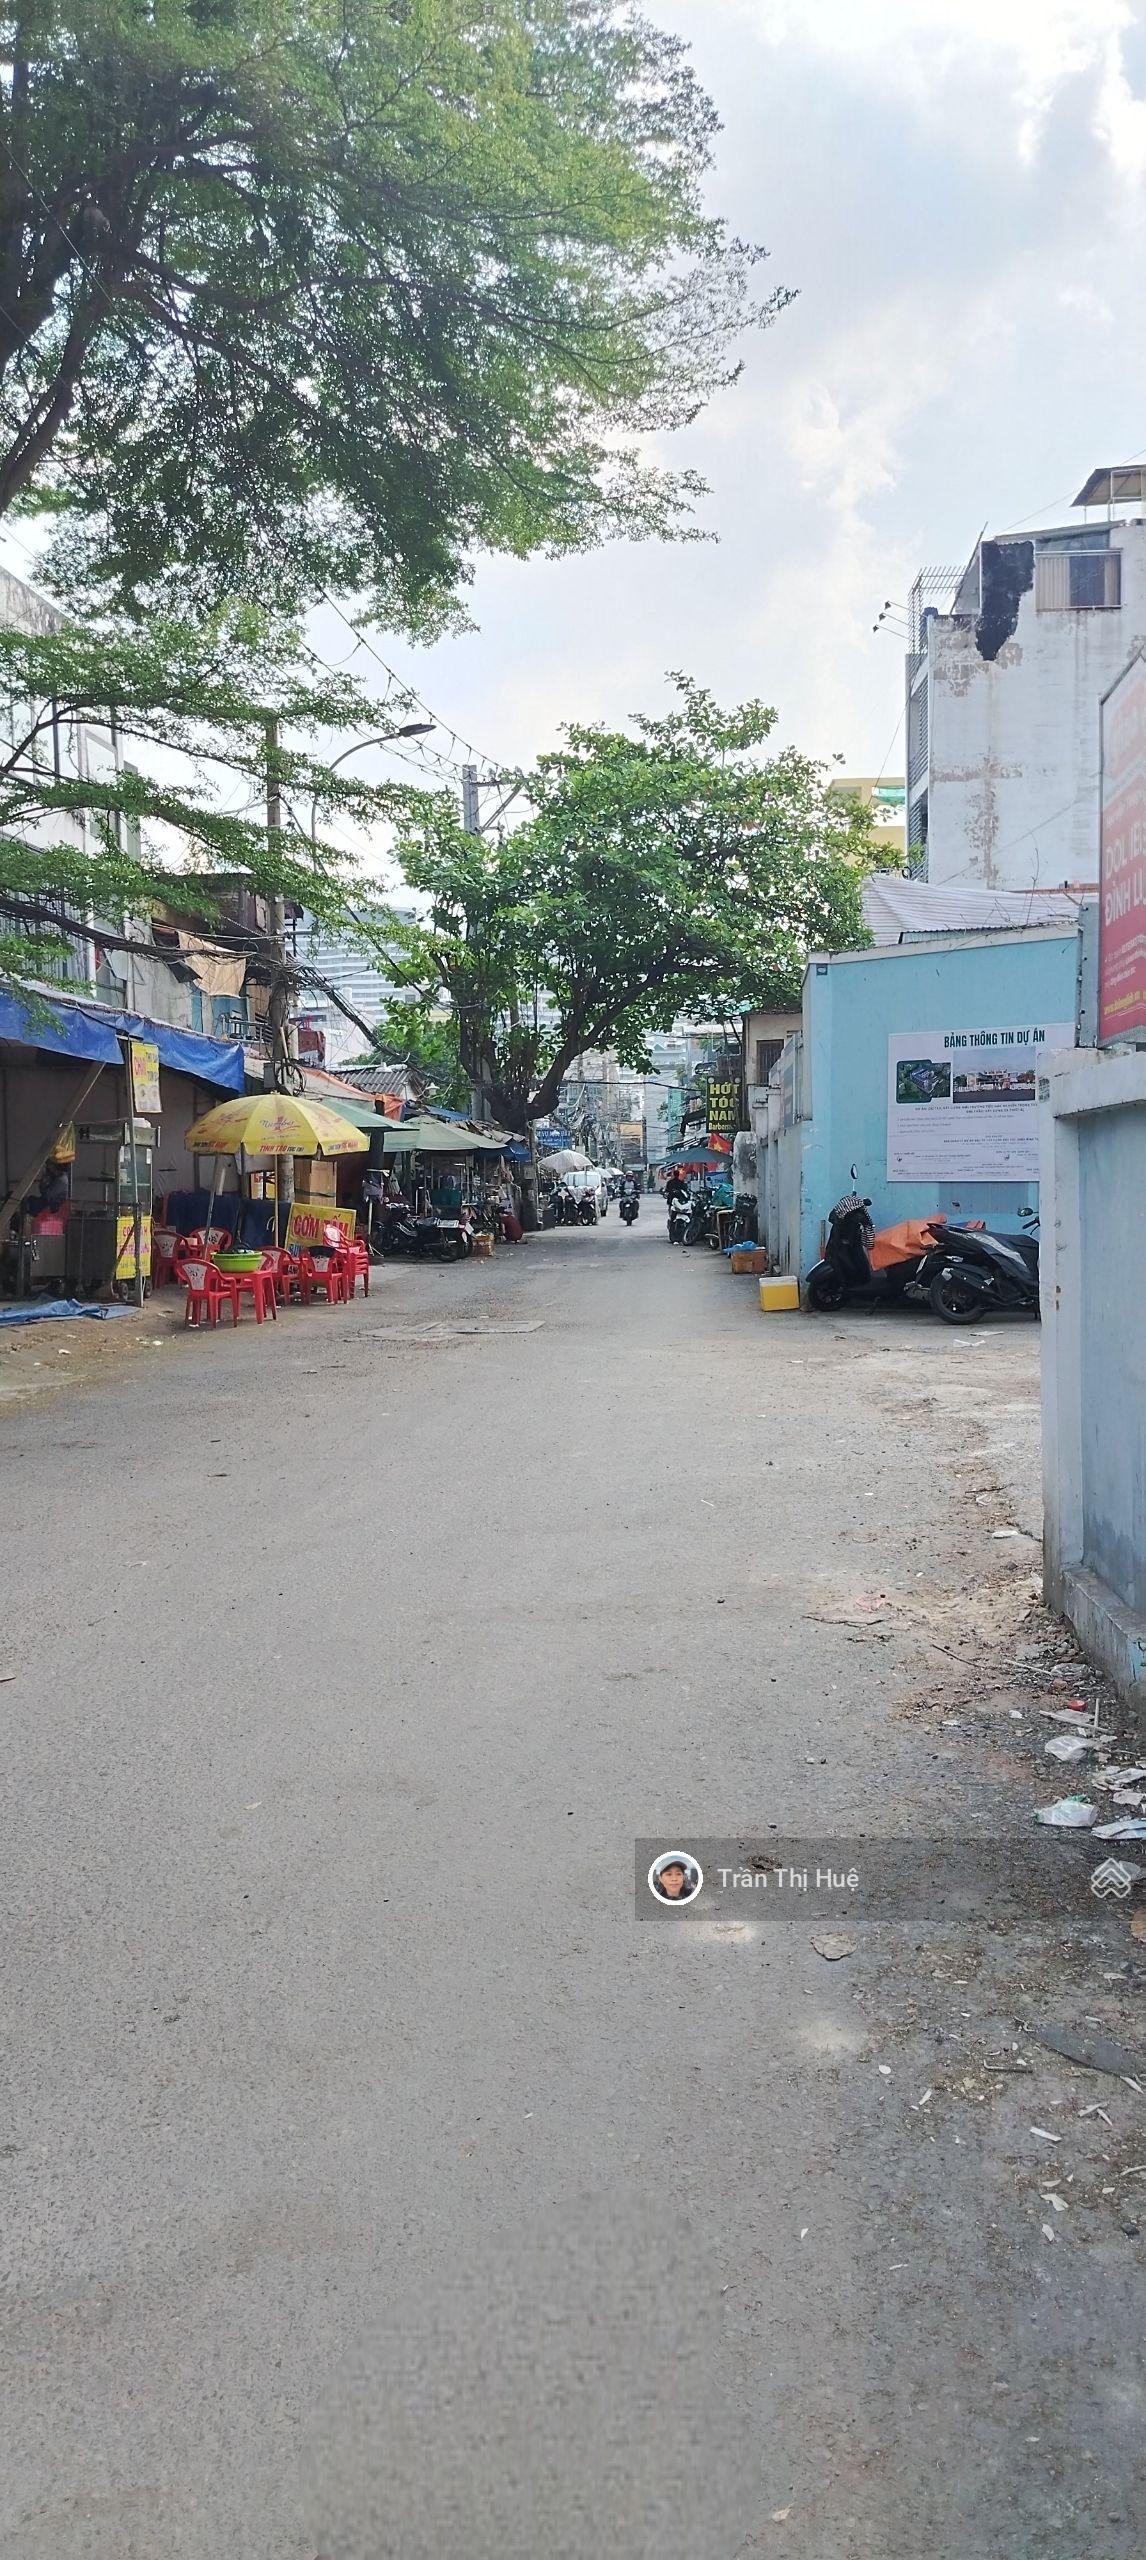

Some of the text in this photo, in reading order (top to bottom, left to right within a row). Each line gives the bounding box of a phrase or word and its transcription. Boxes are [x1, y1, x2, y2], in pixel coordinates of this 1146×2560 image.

[1105, 834, 1128, 880] DOL
[1104, 878, 1131, 927] ĐÌNH
[944, 1027, 1045, 1048] BẢNG THÔNG TIN DỰ ÁN
[709, 1082, 740, 1095] HỚT
[293, 1213, 321, 1239] CƠM
